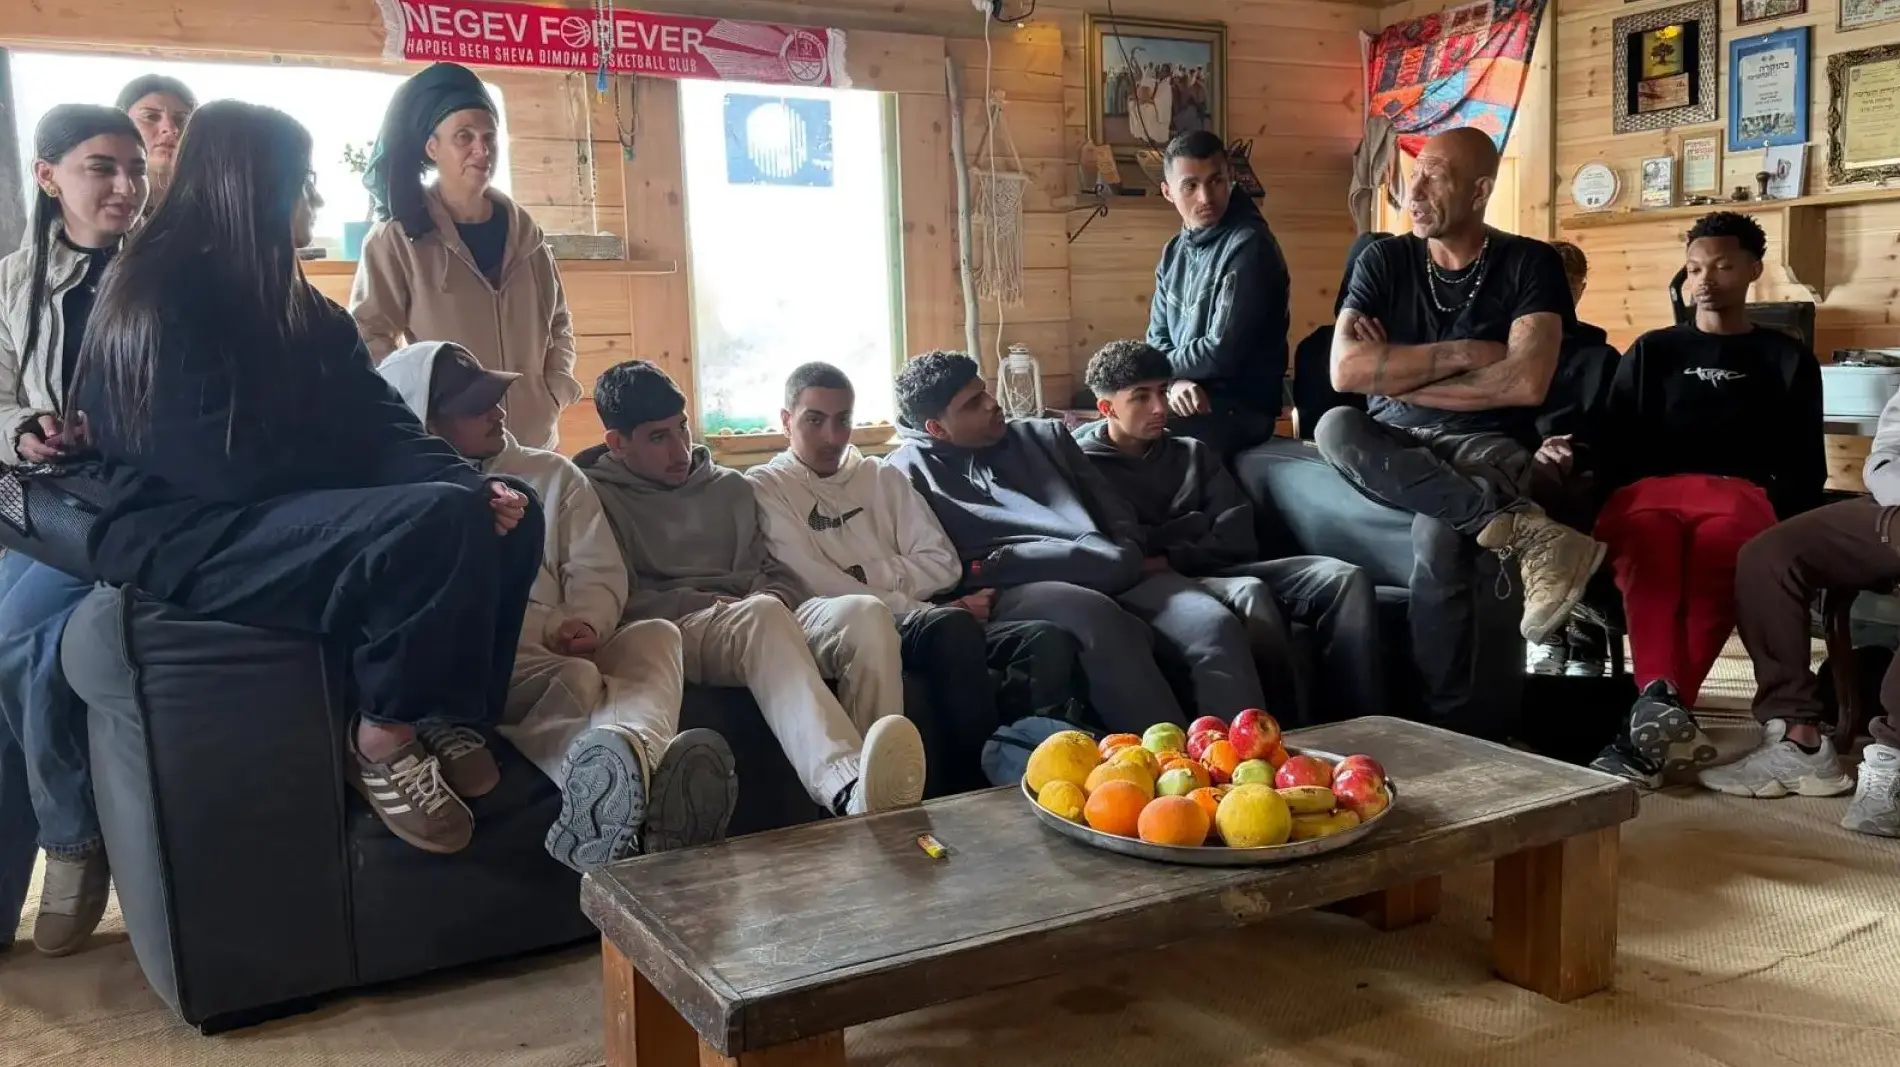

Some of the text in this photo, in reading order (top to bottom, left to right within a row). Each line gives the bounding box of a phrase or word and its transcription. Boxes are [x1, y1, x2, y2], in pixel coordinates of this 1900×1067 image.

[402, 1, 528, 43] NEGEV
[406, 37, 697, 73] HAPOEL BEER SHEVA DIMONA BSKETBALL CLUB
